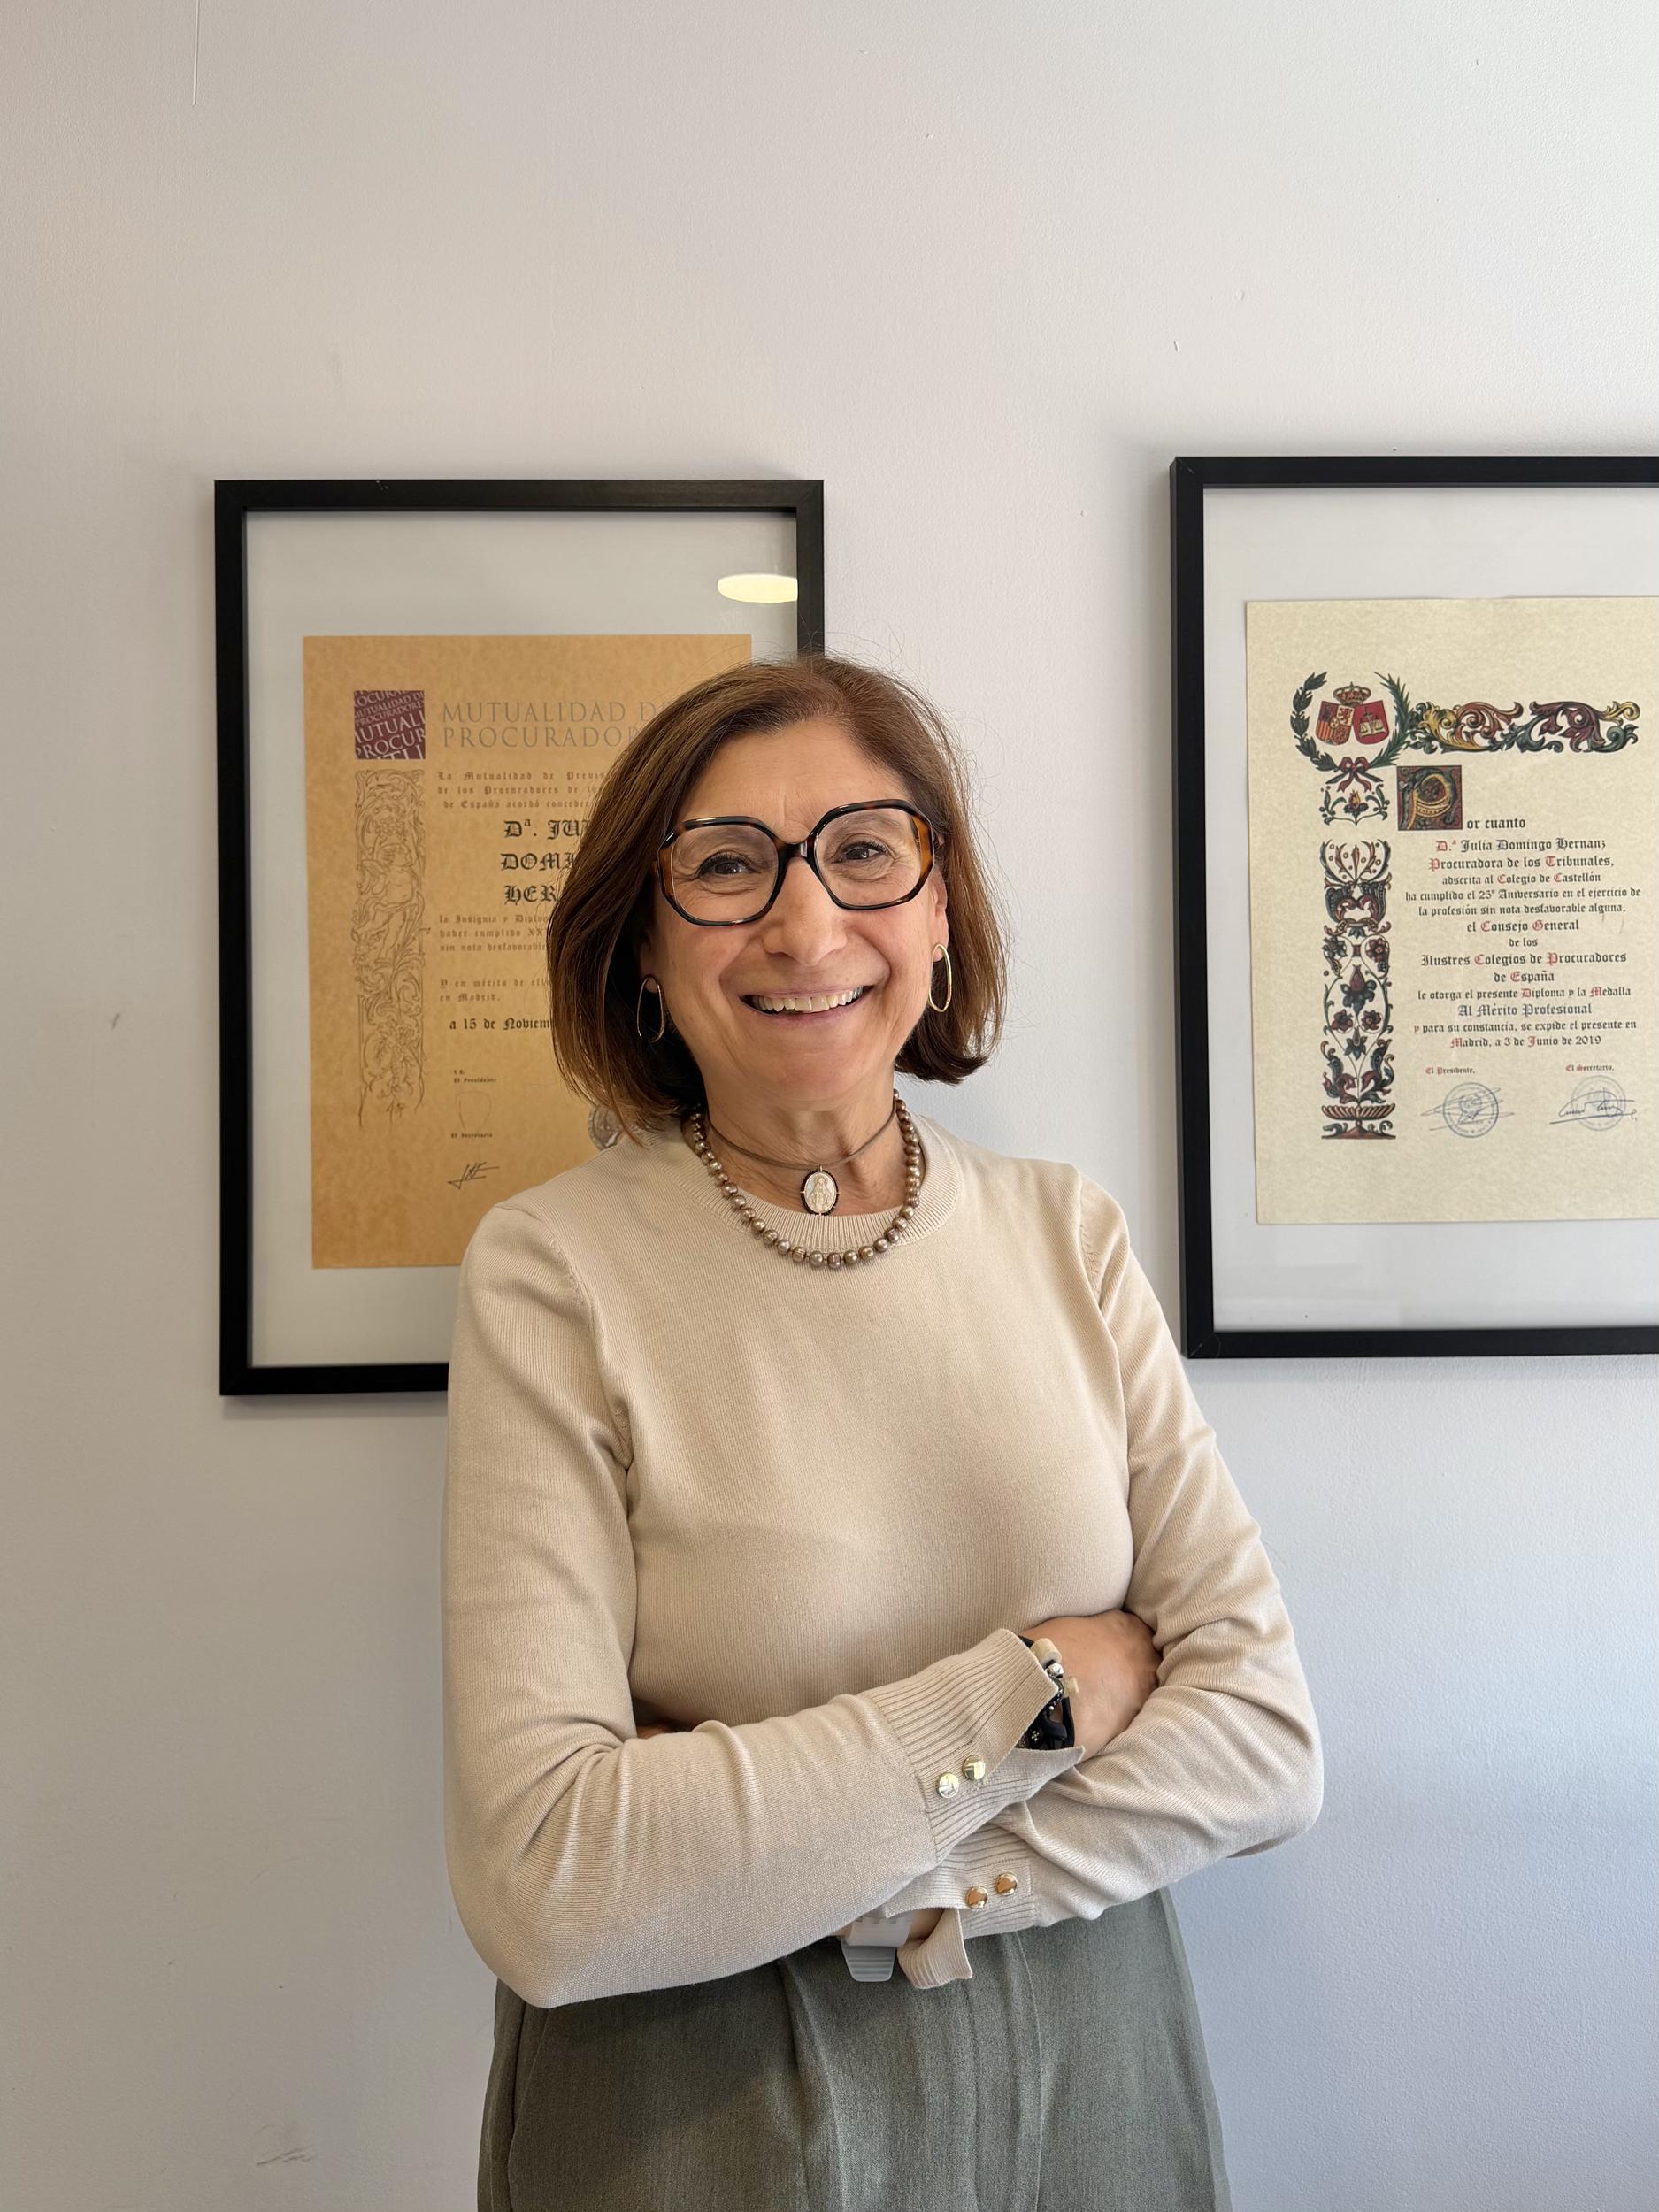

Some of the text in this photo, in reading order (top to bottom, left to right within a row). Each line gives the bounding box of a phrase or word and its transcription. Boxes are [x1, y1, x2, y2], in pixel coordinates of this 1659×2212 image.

[442, 702, 626, 723] MUTUALIDAD
[1485, 818, 1526, 829] cuanto
[1461, 840, 1492, 853] Julia
[1496, 840, 1551, 851] Domingo
[1429, 858, 1502, 872] Procuradora
[1507, 857, 1519, 867] de
[1524, 856, 1540, 867] los
[1442, 876, 1480, 885] adscrita
[1485, 875, 1493, 884] al
[1497, 874, 1536, 885] Colegio
[1554, 871, 1601, 882] Castellón
[1406, 892, 1417, 902] ha
[1420, 891, 1463, 902] cumplido
[1467, 891, 1475, 900] el
[1498, 889, 1558, 899] Aniversario
[1577, 888, 1585, 897] el
[1588, 889, 1627, 898] ejercicio
[1630, 887, 1640, 896] de
[1419, 907, 1427, 916] la
[1432, 904, 1477, 917] profesión
[1524, 903, 1586, 913] desfavorable
[1467, 919, 1578, 933] el Consejo General
[1509, 938, 1538, 947] de los
[1421, 952, 1626, 966] Ilustres Colegios de Procuradores
[1494, 971, 1554, 983] de España
[1418, 991, 1426, 1000] le
[1430, 991, 1461, 1001] otorga
[1465, 989, 1473, 999] el
[1477, 990, 1517, 1000] presente
[1522, 988, 1564, 998] Diploma
[1578, 987, 1586, 996] la
[1590, 987, 1631, 997] Medalla
[1458, 1003, 1592, 1017] Al Mérito Profesional
[464, 1018, 477, 1030] 15
[484, 1018, 495, 1029] de
[1535, 1021, 1566, 1032] expide
[1570, 1020, 1578, 1030] el
[1581, 1021, 1622, 1031] presente
[1504, 1037, 1510, 1046] 3
[1514, 1037, 1525, 1046] de
[1528, 1036, 1558, 1048] Junio
[1562, 1036, 1572, 1045] de
[1576, 1035, 1601, 1045] 2019
